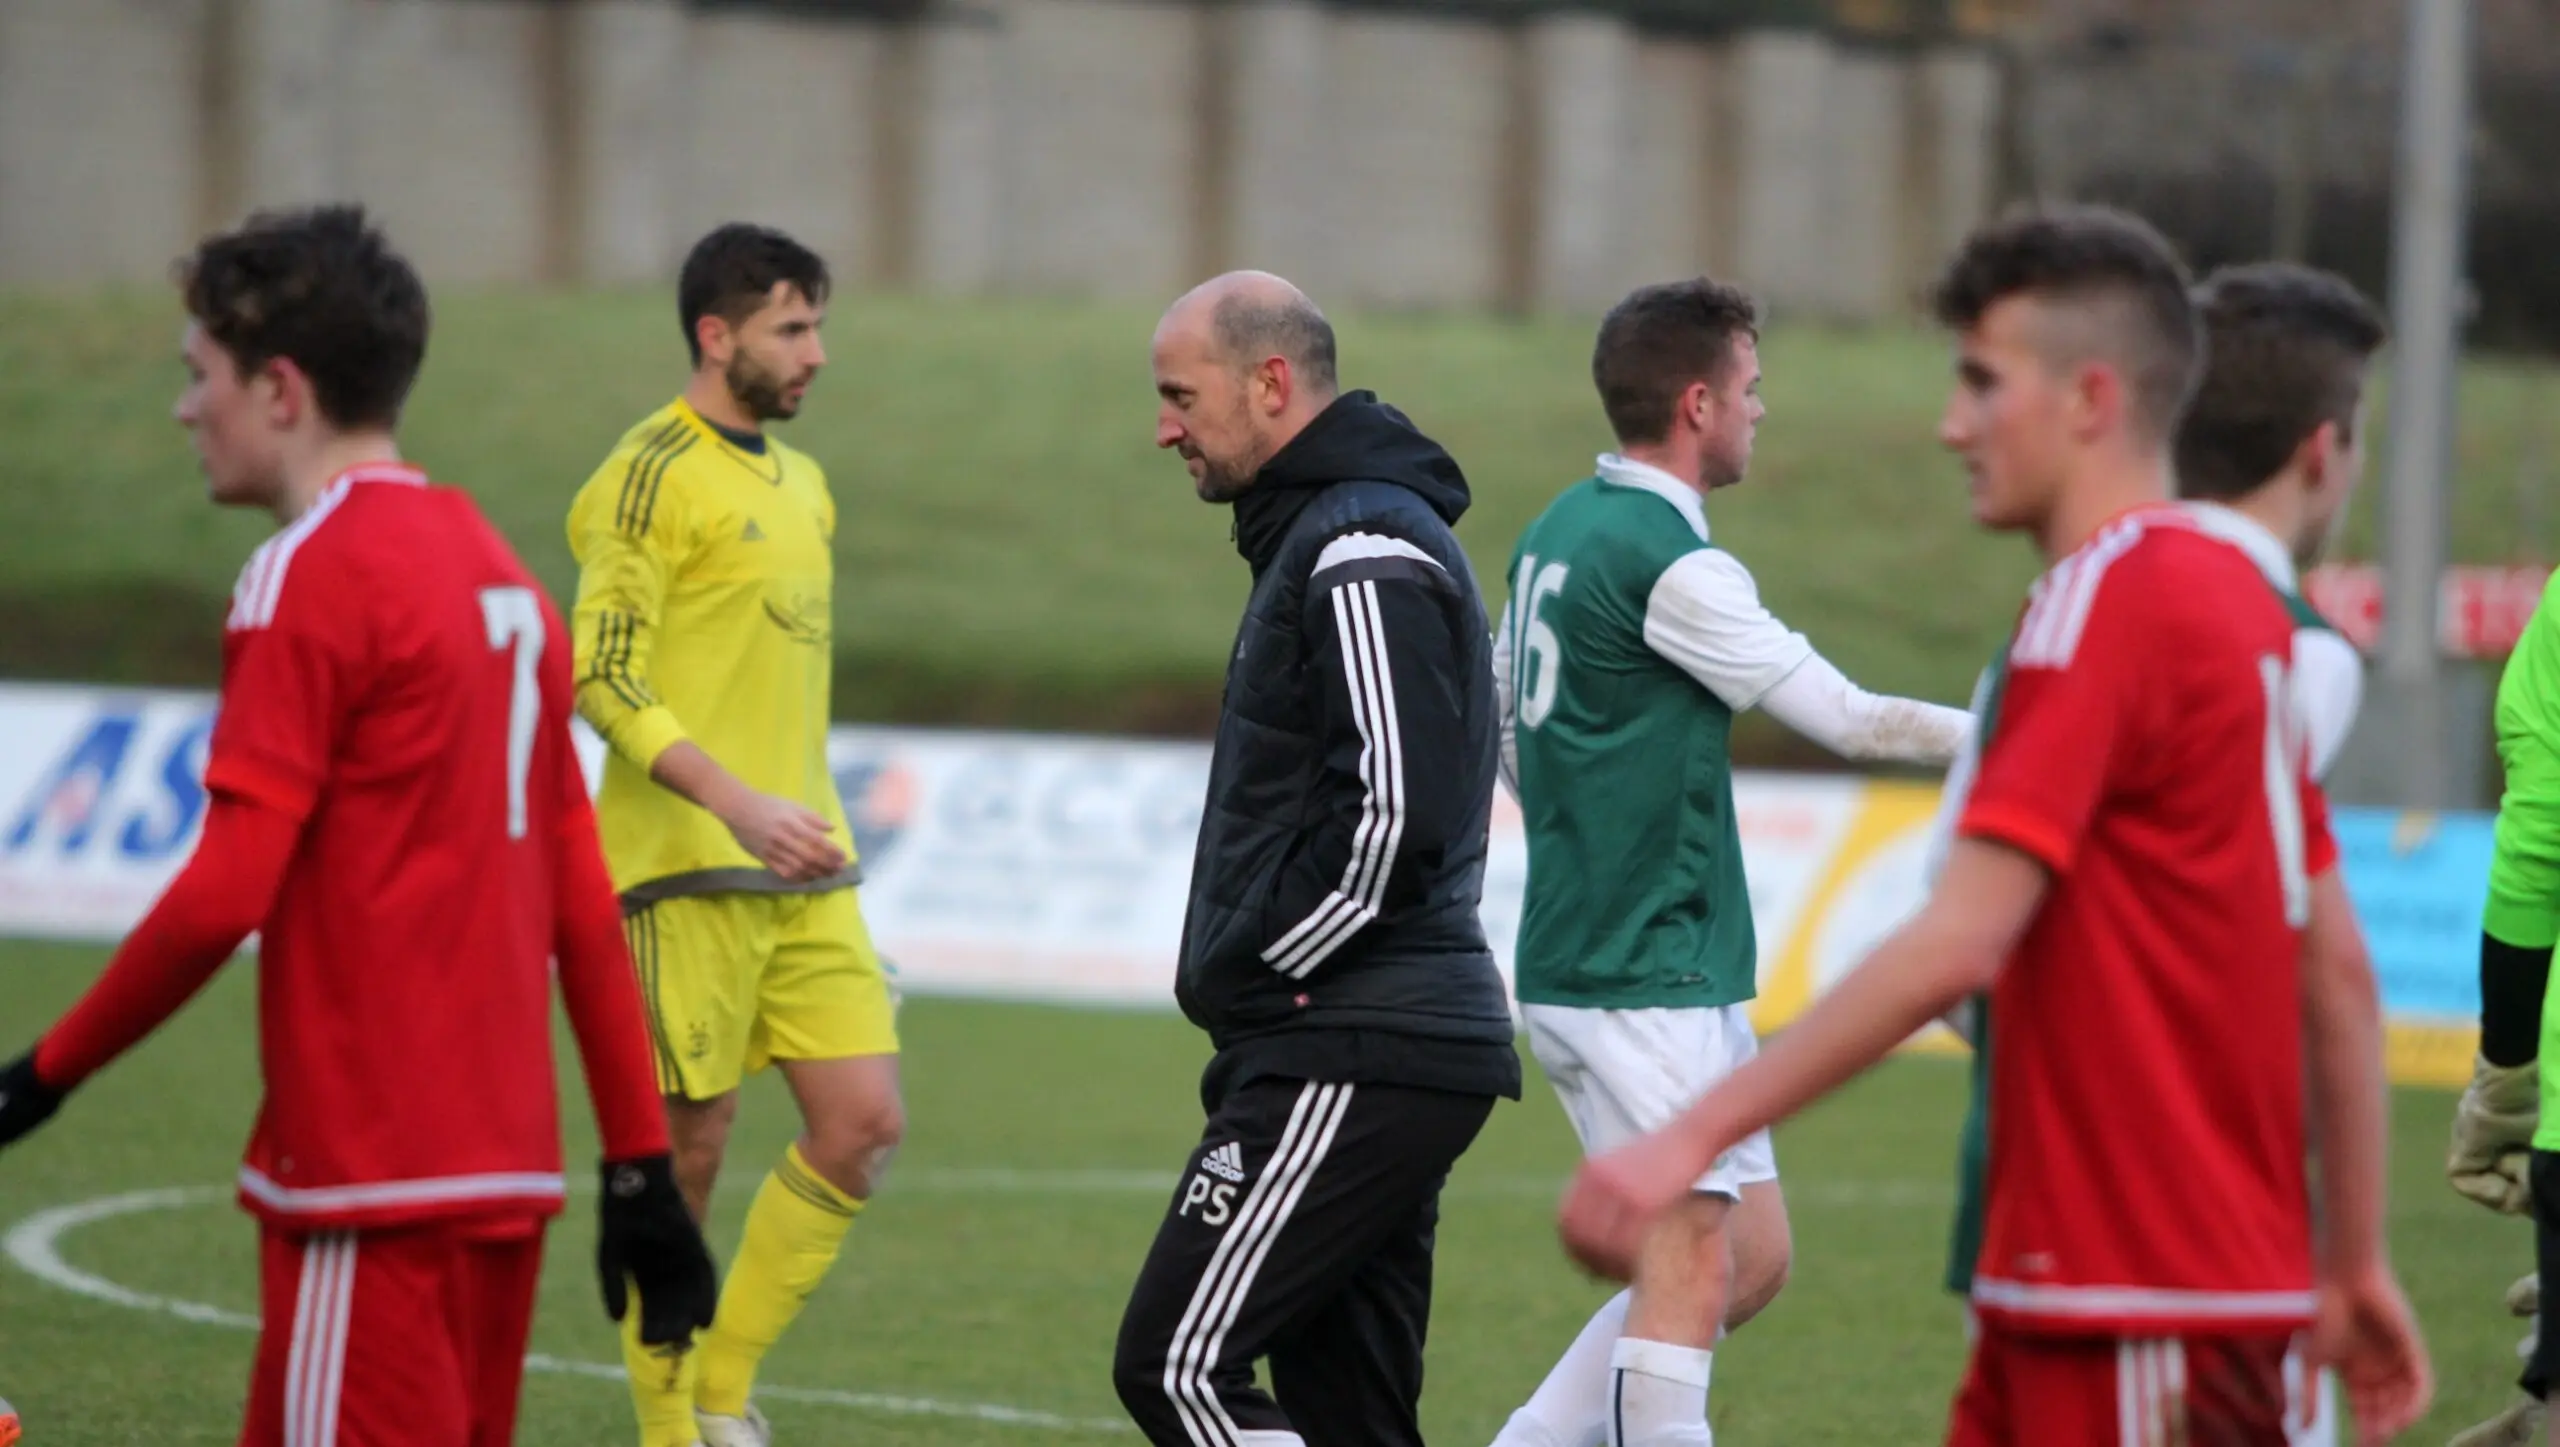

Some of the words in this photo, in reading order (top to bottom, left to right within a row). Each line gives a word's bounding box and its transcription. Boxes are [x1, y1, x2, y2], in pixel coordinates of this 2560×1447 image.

[477, 585, 546, 840] 7
[1513, 554, 1570, 731] 16
[1179, 1172, 1237, 1226] PS
